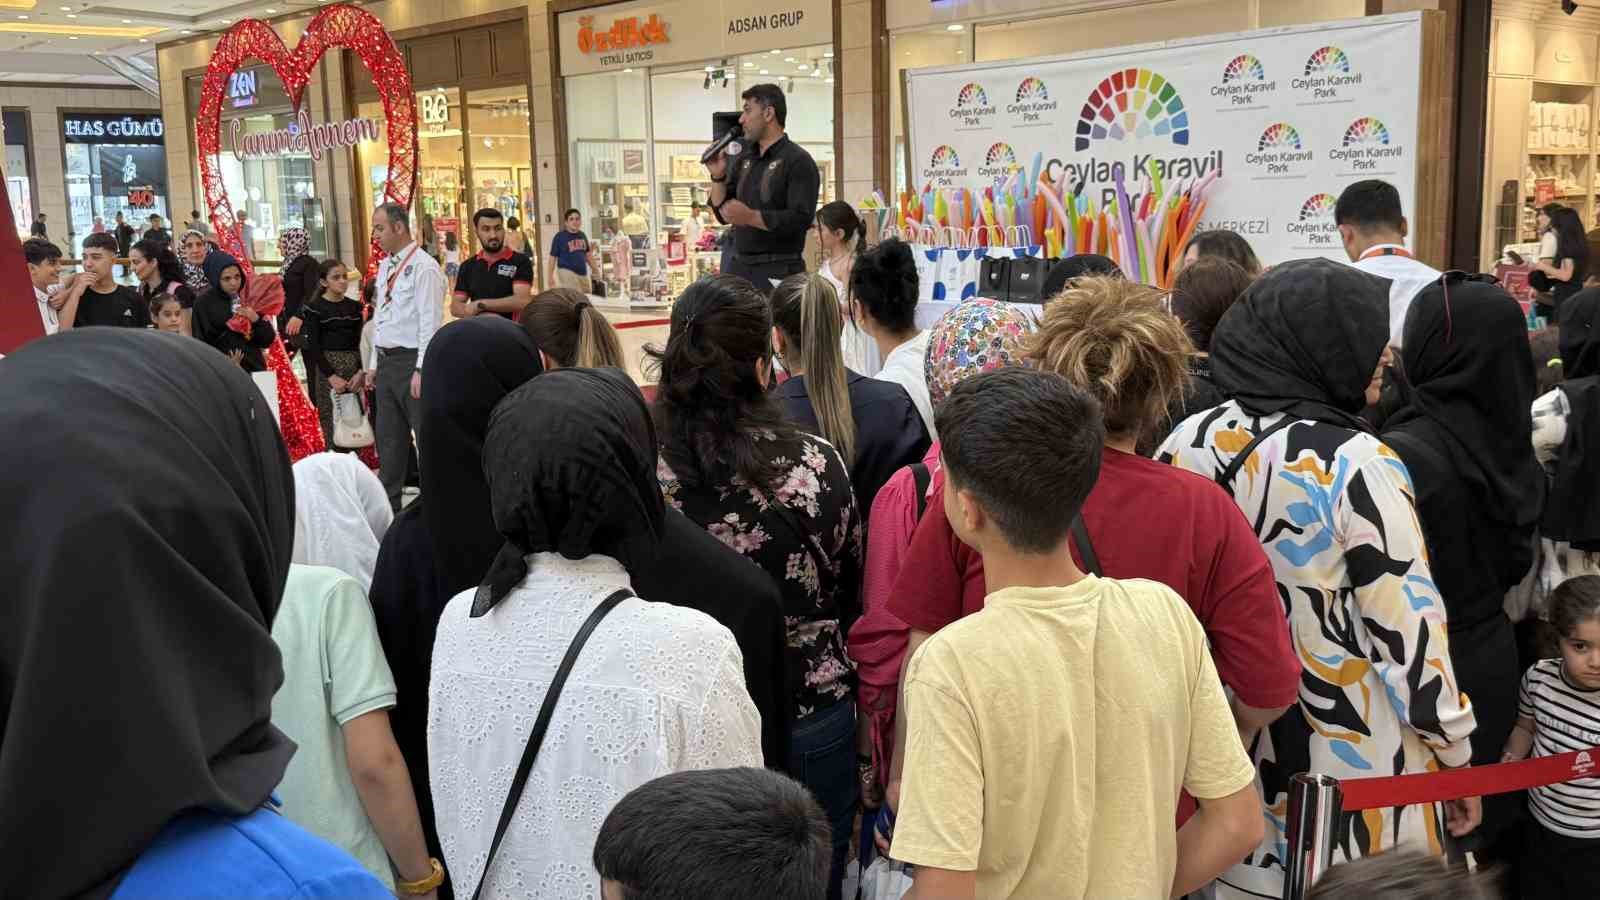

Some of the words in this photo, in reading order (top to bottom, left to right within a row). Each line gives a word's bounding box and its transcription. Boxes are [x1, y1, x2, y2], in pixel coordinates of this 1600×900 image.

[728, 16, 767, 35] ADSAN
[770, 10, 804, 29] GRUP
[230, 71, 256, 98] ZEN
[1211, 85, 1241, 98] Ceylan
[1244, 81, 1275, 92] Karavil
[1291, 78, 1325, 91] Ceylan
[1327, 74, 1362, 86] Karavil
[1231, 95, 1252, 105] Park
[1314, 88, 1336, 98] Park
[65, 120, 104, 136] HAS
[295, 110, 378, 162] Annem
[1246, 153, 1277, 166] Ceylan
[1280, 150, 1312, 162] Karavil
[1329, 148, 1364, 162] Ceylan
[1366, 146, 1402, 158] Karavil
[1267, 164, 1288, 174] Park
[1353, 159, 1375, 170] Park
[1287, 222, 1320, 234] Ceylan
[1309, 234, 1330, 243] Park
